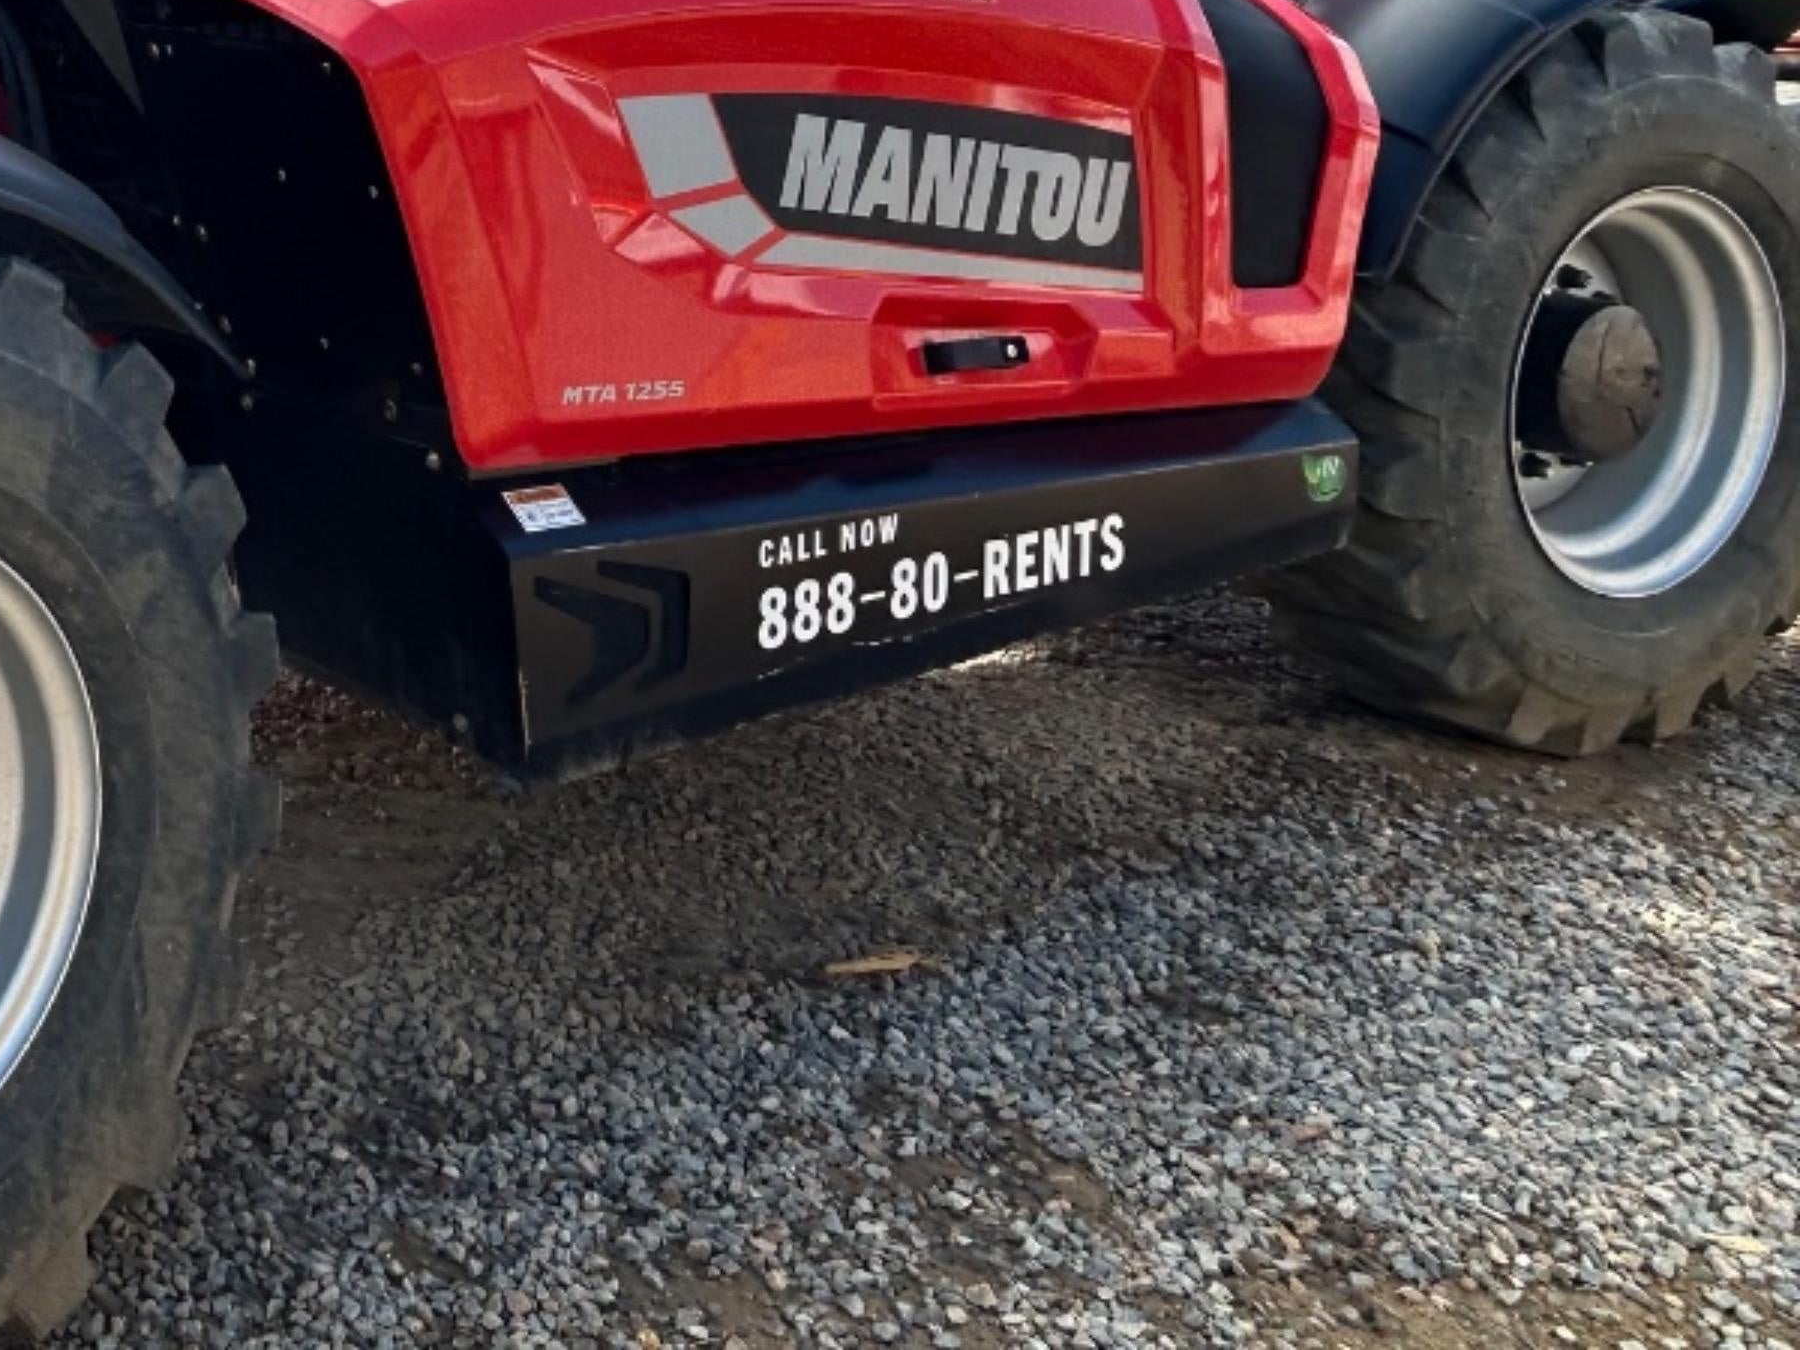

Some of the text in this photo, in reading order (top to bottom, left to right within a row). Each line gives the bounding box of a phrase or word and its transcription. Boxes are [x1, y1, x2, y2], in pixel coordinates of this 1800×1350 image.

[778, 112, 1132, 248] MANITOU
[561, 379, 686, 406] MTA 1255
[756, 512, 1126, 650] 888-80-RENTS
[757, 511, 900, 569] CALL NOW
